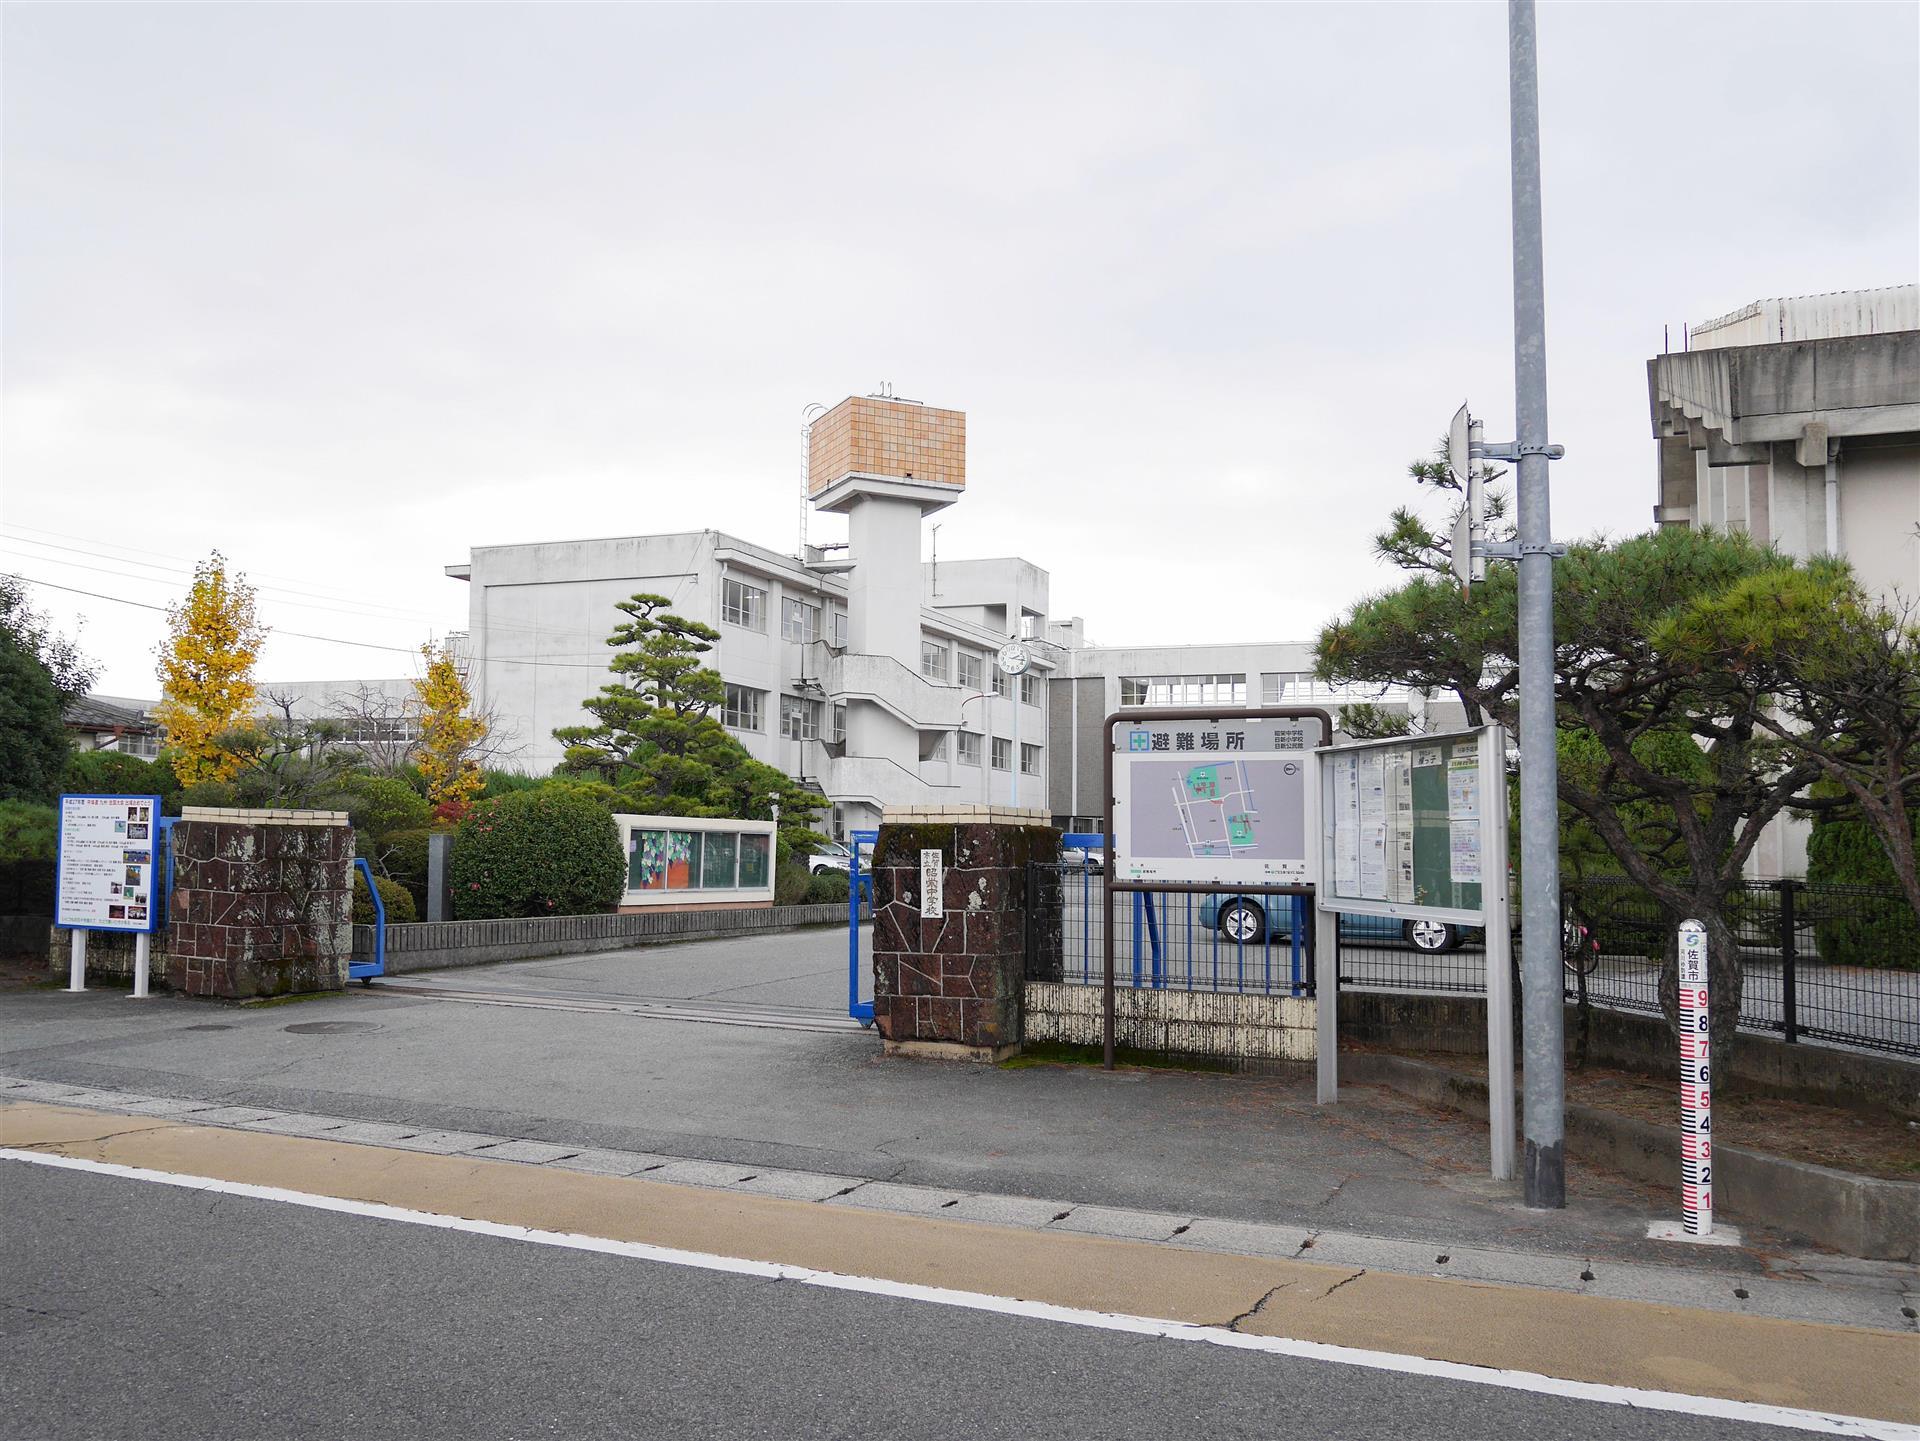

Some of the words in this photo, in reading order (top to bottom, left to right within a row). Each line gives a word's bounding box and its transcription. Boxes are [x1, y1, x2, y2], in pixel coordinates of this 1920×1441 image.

[1151, 731, 1245, 751] 避難場所
[1687, 948, 1699, 981] 佐賀市
[1698, 990, 1707, 1007] 9
[1699, 1015, 1708, 1032] 8
[1699, 1040, 1708, 1056] 7
[1699, 1065, 1709, 1082] 6
[1700, 1091, 1709, 1107] 5
[1700, 1116, 1710, 1132] 4
[1701, 1141, 1710, 1158] 3
[1701, 1167, 1711, 1183] 2
[1702, 1192, 1710, 1208] 1
